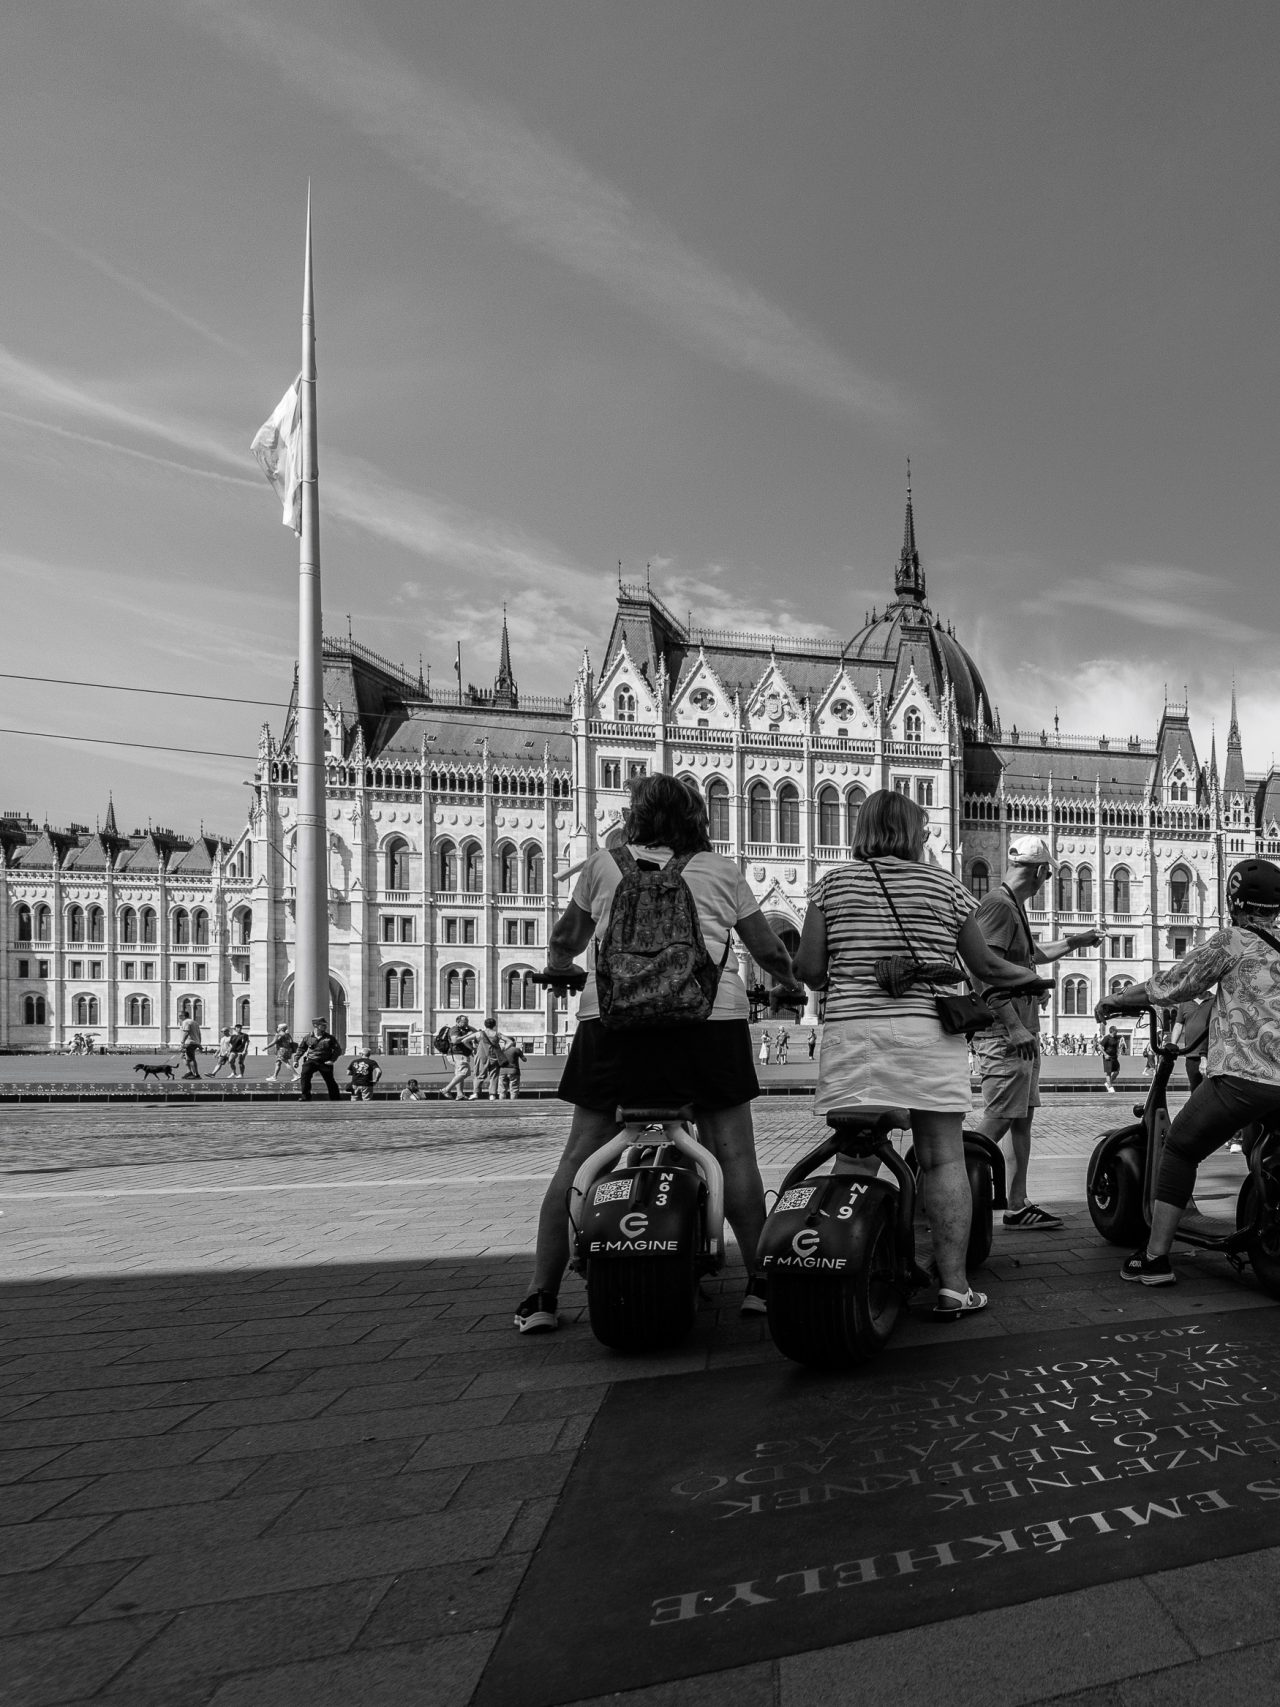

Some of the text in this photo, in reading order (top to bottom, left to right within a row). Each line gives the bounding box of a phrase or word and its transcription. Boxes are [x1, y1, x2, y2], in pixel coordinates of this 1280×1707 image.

[1100, 1326, 1205, 1341] 2020.
[752, 1376, 1231, 1457] MAGYARORSZÁG
[841, 1367, 1158, 1420] ÁLLÍTTATTA
[1089, 1408, 1151, 1426] ÉS
[1113, 1419, 1226, 1451] ÉLŐ
[853, 1420, 1072, 1466] HAZÁT
[670, 1456, 835, 1496] ADÓ
[715, 1440, 1095, 1519] NÉPEKNEK
[649, 1489, 1233, 1625] EMLÉKHELYE
